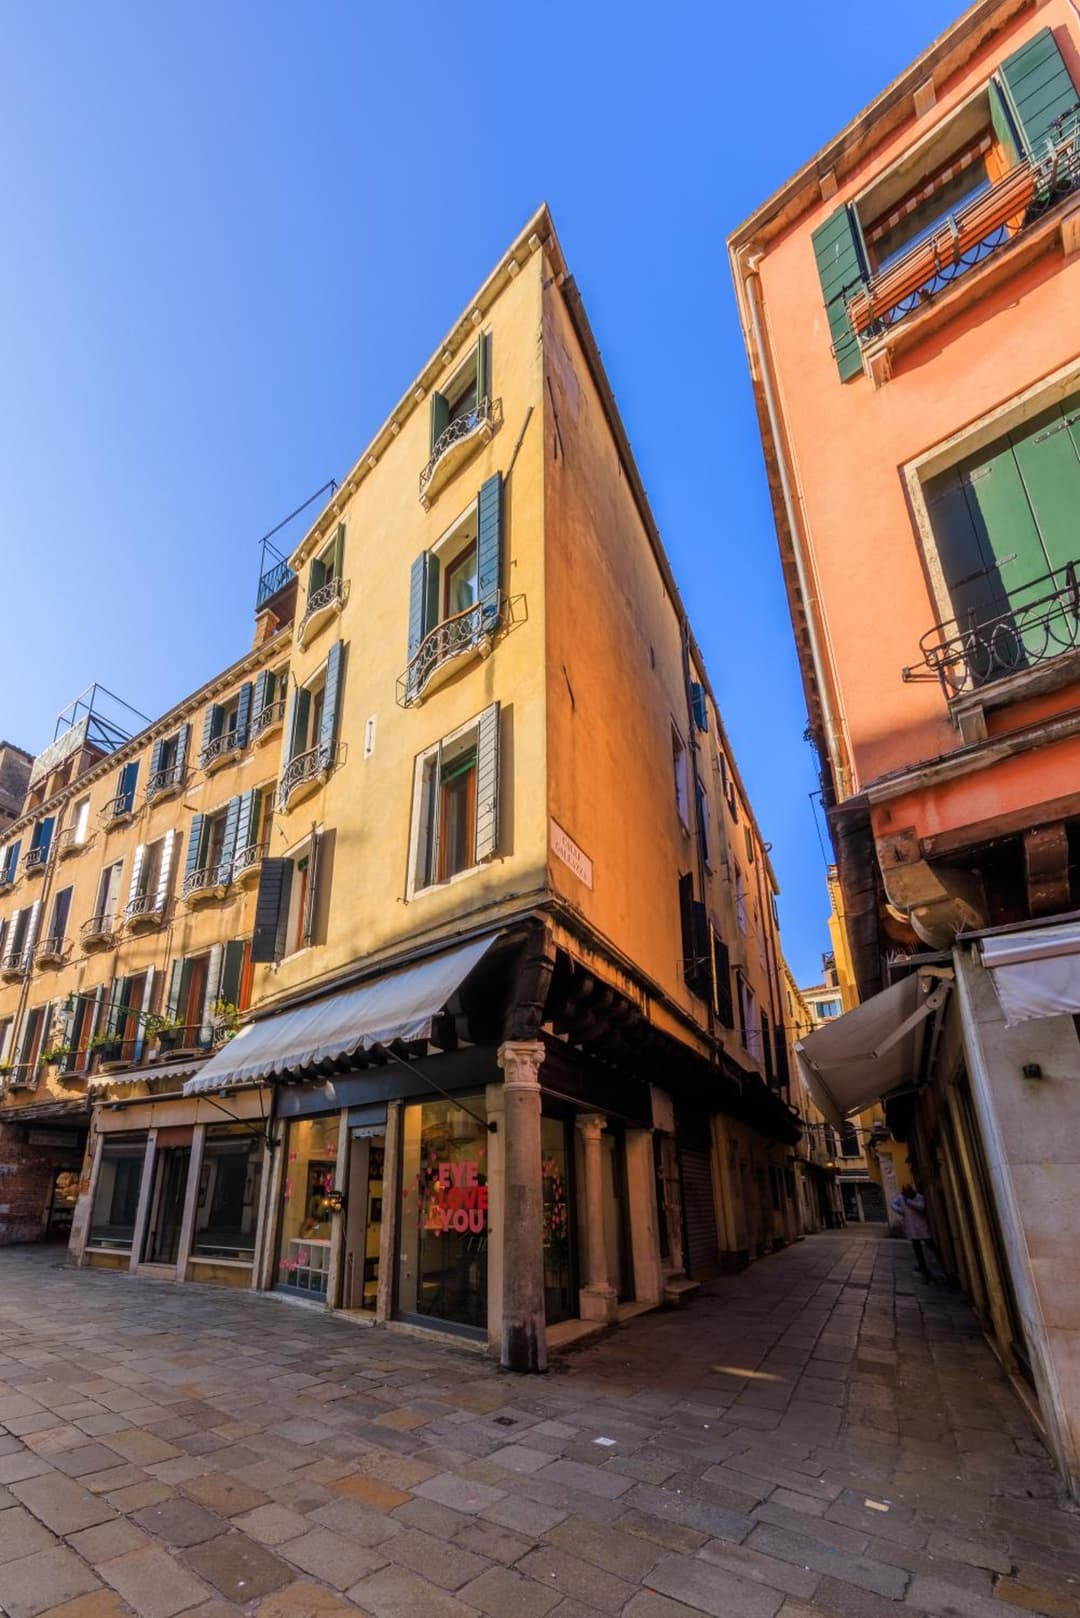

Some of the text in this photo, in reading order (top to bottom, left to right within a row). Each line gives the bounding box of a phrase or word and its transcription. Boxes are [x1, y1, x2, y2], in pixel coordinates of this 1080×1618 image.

[438, 1162, 478, 1187] EYE
[438, 1186, 488, 1210] LOVE
[440, 1208, 484, 1233] YOU
